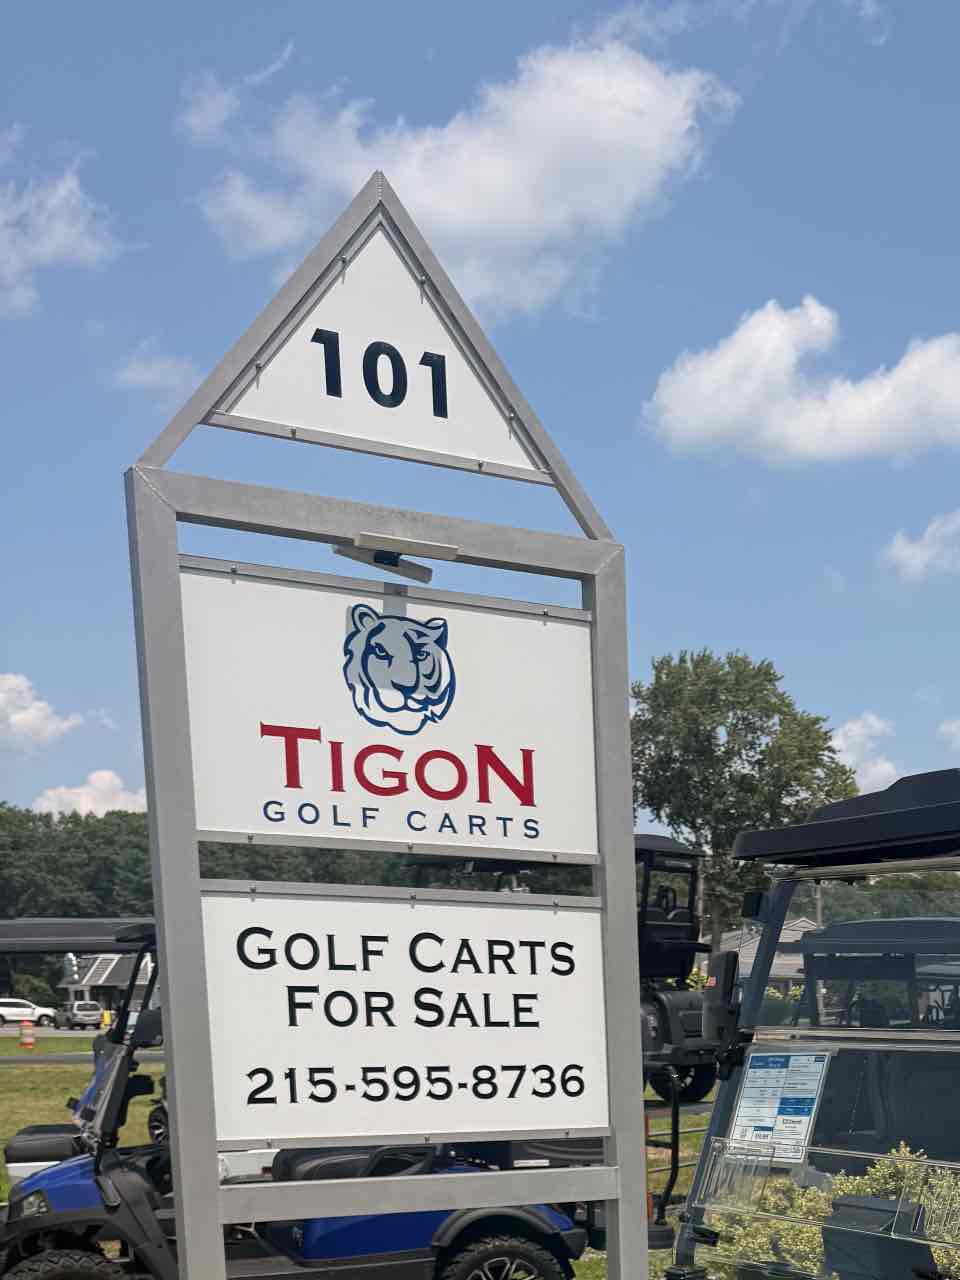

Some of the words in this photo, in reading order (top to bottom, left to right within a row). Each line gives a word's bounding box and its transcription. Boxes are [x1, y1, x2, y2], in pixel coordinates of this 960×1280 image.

[311, 327, 449, 419] 101
[259, 721, 537, 808] TIGON
[262, 800, 380, 828] GOLF
[406, 810, 540, 839] CARTS
[236, 926, 389, 972] GOLF
[408, 931, 576, 977] CARTS
[285, 984, 397, 1028] FOR
[413, 986, 540, 1028] SALE
[245, 1063, 585, 1105] 215-595-8736
